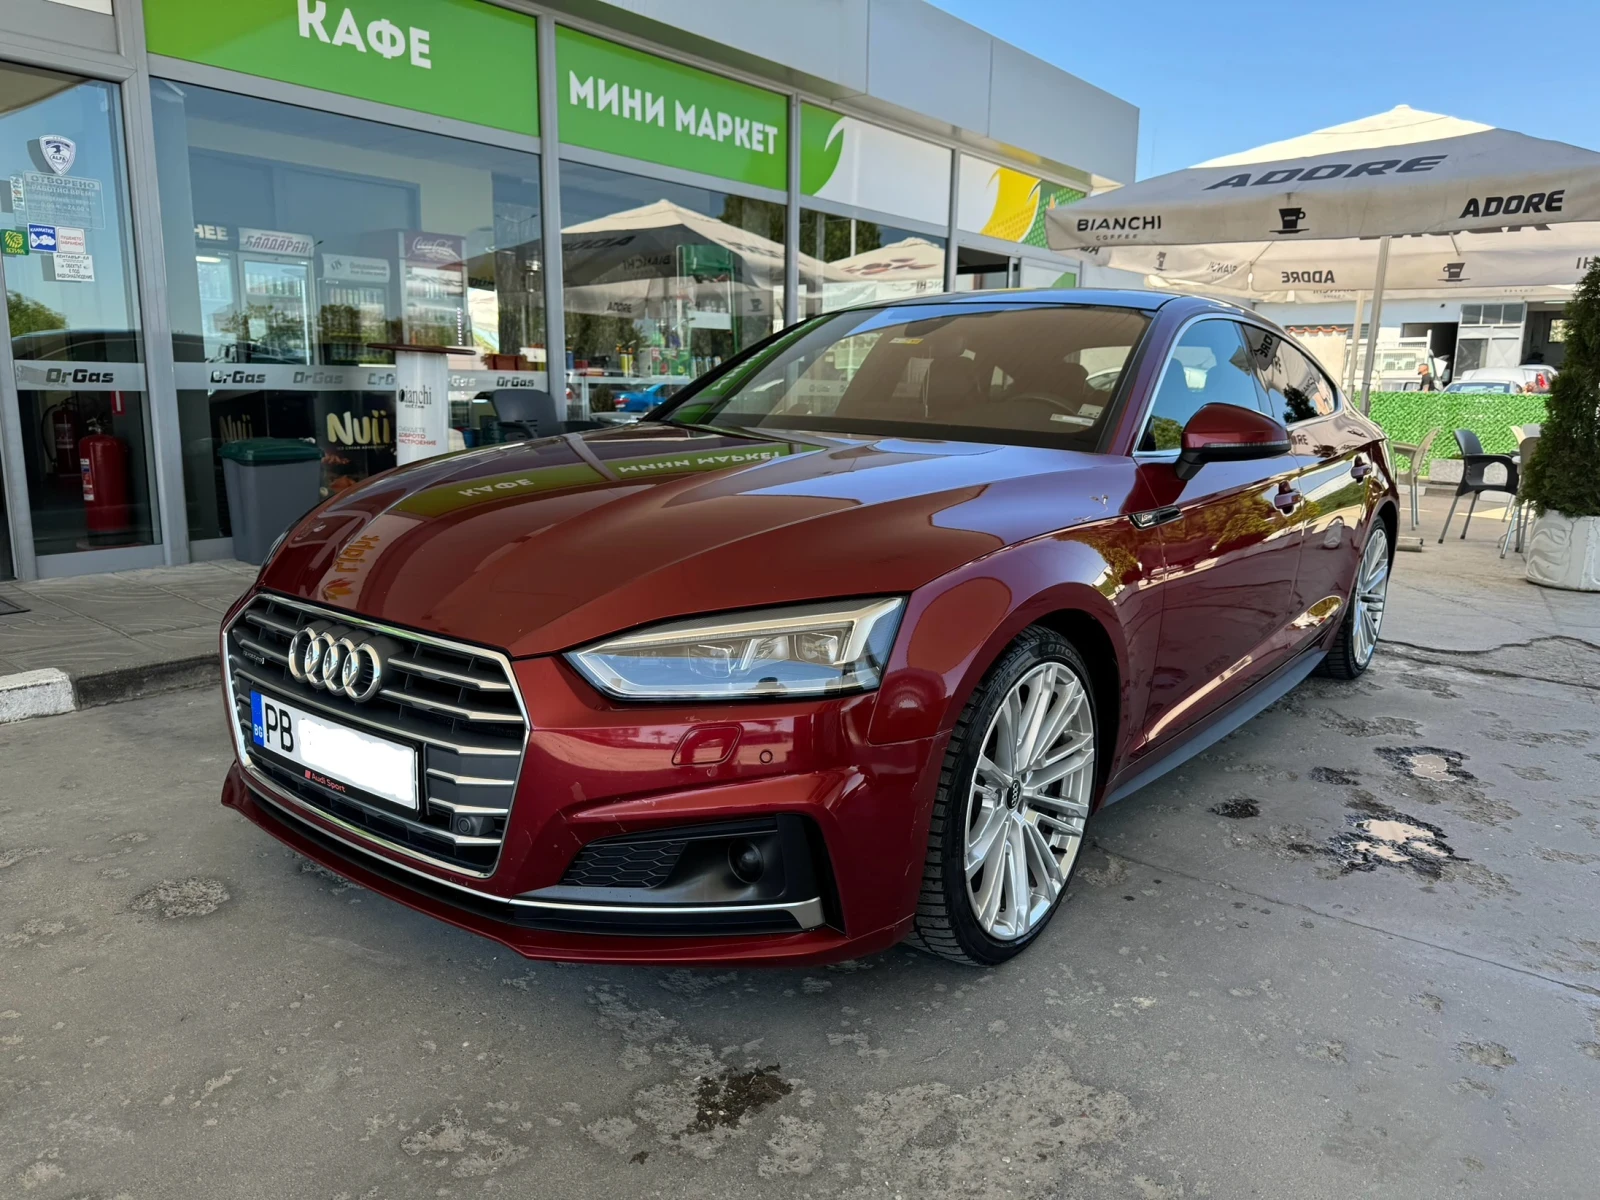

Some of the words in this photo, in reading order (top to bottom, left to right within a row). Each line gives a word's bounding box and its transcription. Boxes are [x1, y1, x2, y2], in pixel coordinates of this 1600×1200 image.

[297, 0, 432, 69] КАФЕ
[569, 70, 665, 128] МИНИ
[675, 99, 778, 155] МАРКЕТ
[1203, 154, 1448, 190] ADORE
[31, 175, 95, 189] ОТВОРЕНО
[1459, 189, 1565, 219] ADORE
[1077, 215, 1161, 232] BIANCHI
[1095, 233, 1138, 241] COFFEE
[46, 368, 114, 383] OrGas
[210, 370, 266, 384] OrGas
[293, 371, 343, 384] OrGas
[367, 372, 395, 386] OrG
[497, 376, 534, 388] OrGas
[398, 383, 432, 405] bianchi
[327, 409, 390, 446] Nuii
[254, 723, 263, 738] BG
[265, 702, 294, 753] PB
[311, 773, 326, 785] Audi
[326, 778, 346, 793] Sport
